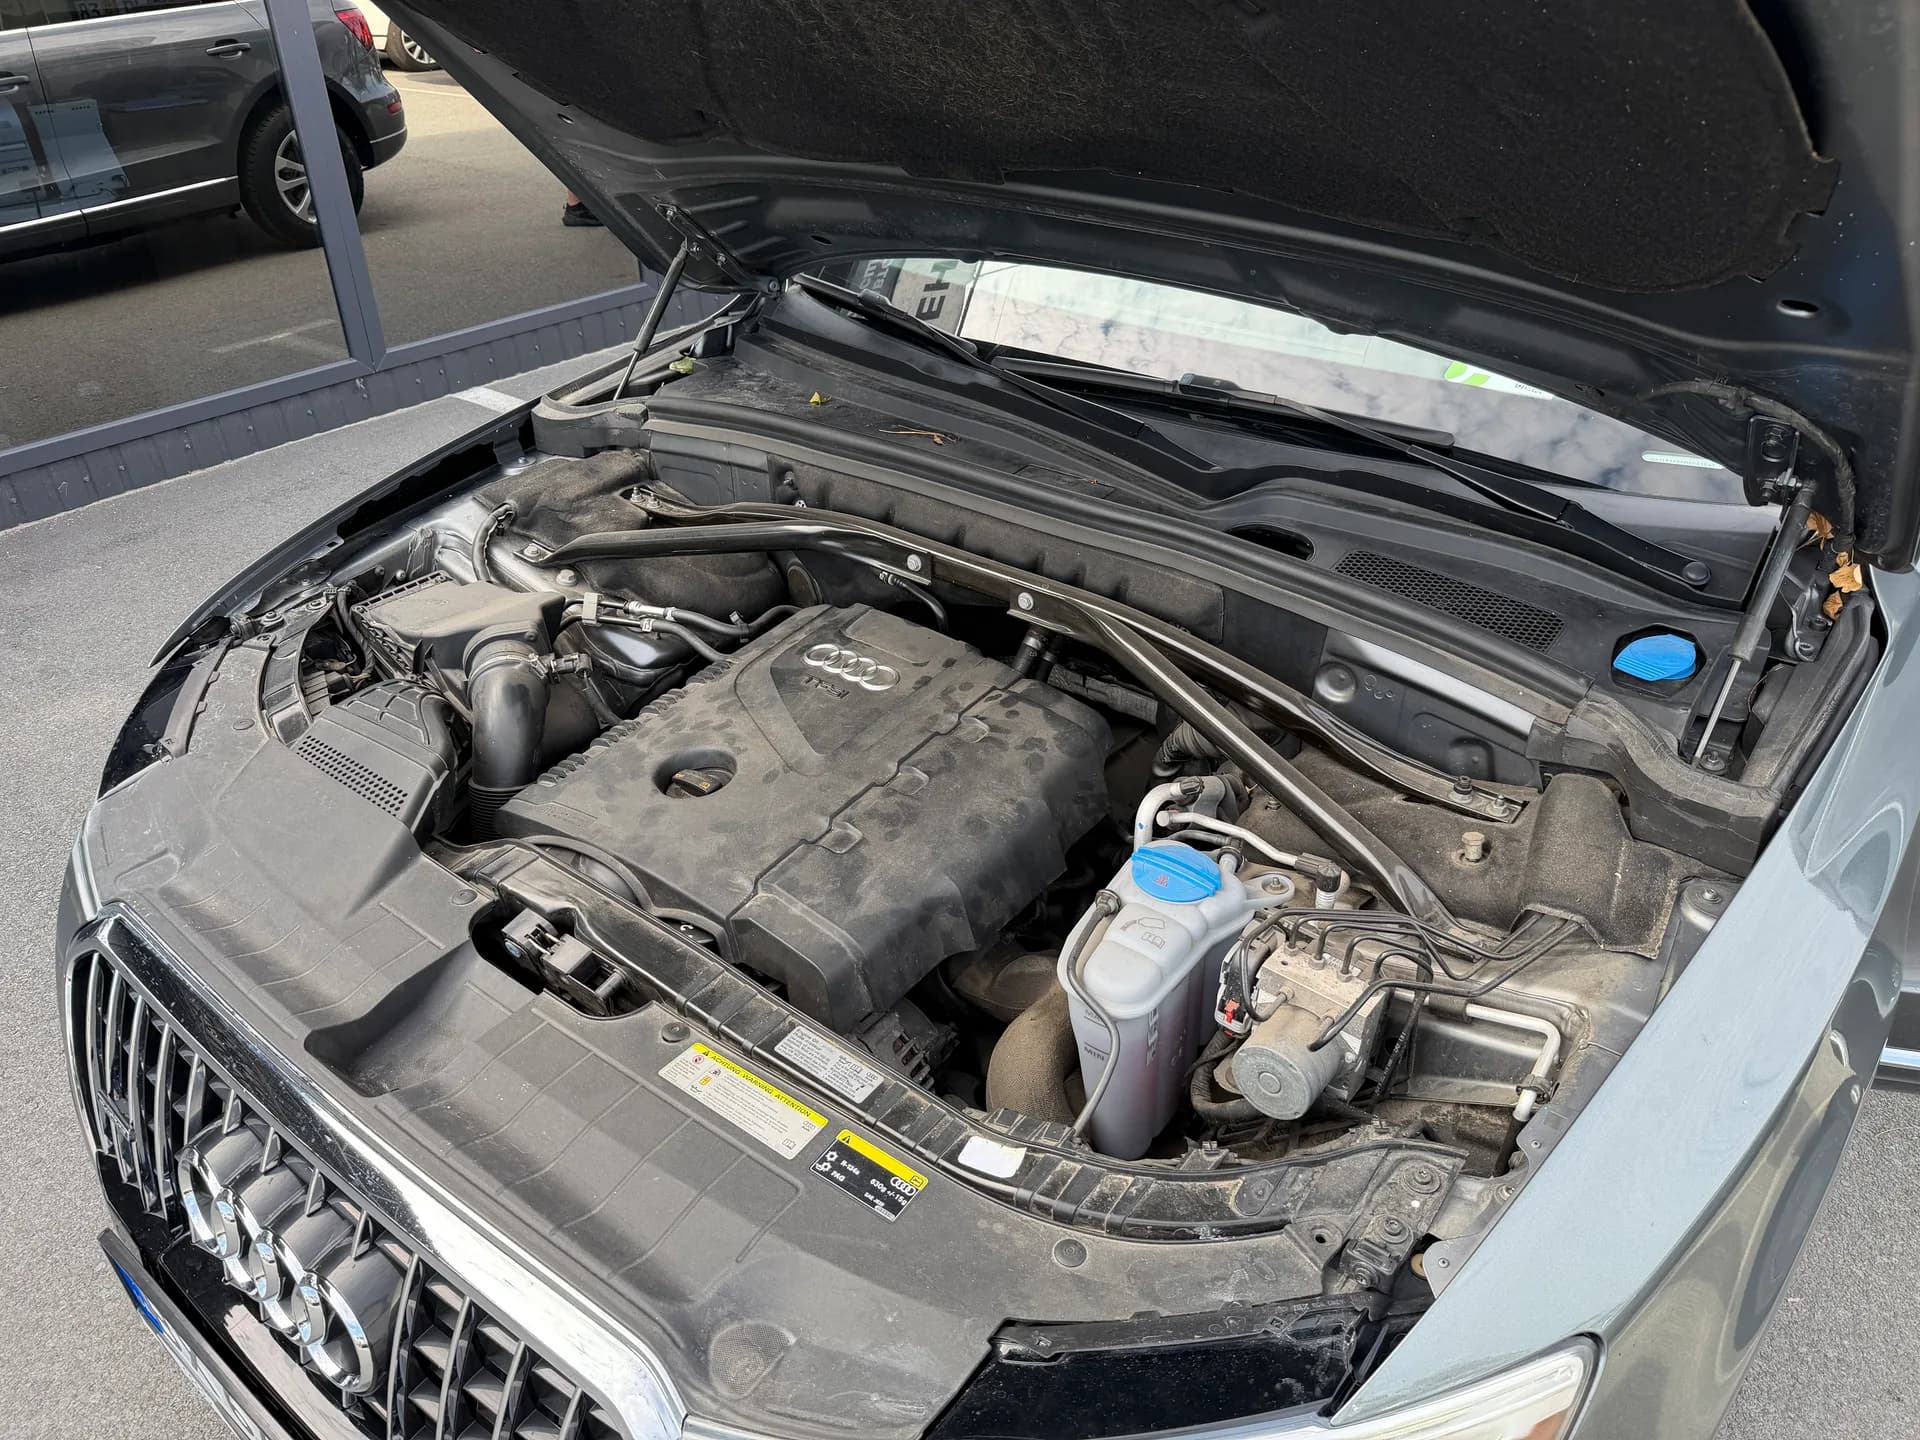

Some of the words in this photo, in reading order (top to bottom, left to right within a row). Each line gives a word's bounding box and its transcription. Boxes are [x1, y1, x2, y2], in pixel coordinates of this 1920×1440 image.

[711, 1055, 740, 1075] ACHTUNG
[742, 1074, 773, 1094] WARNING
[775, 1093, 811, 1117] ATTENTION
